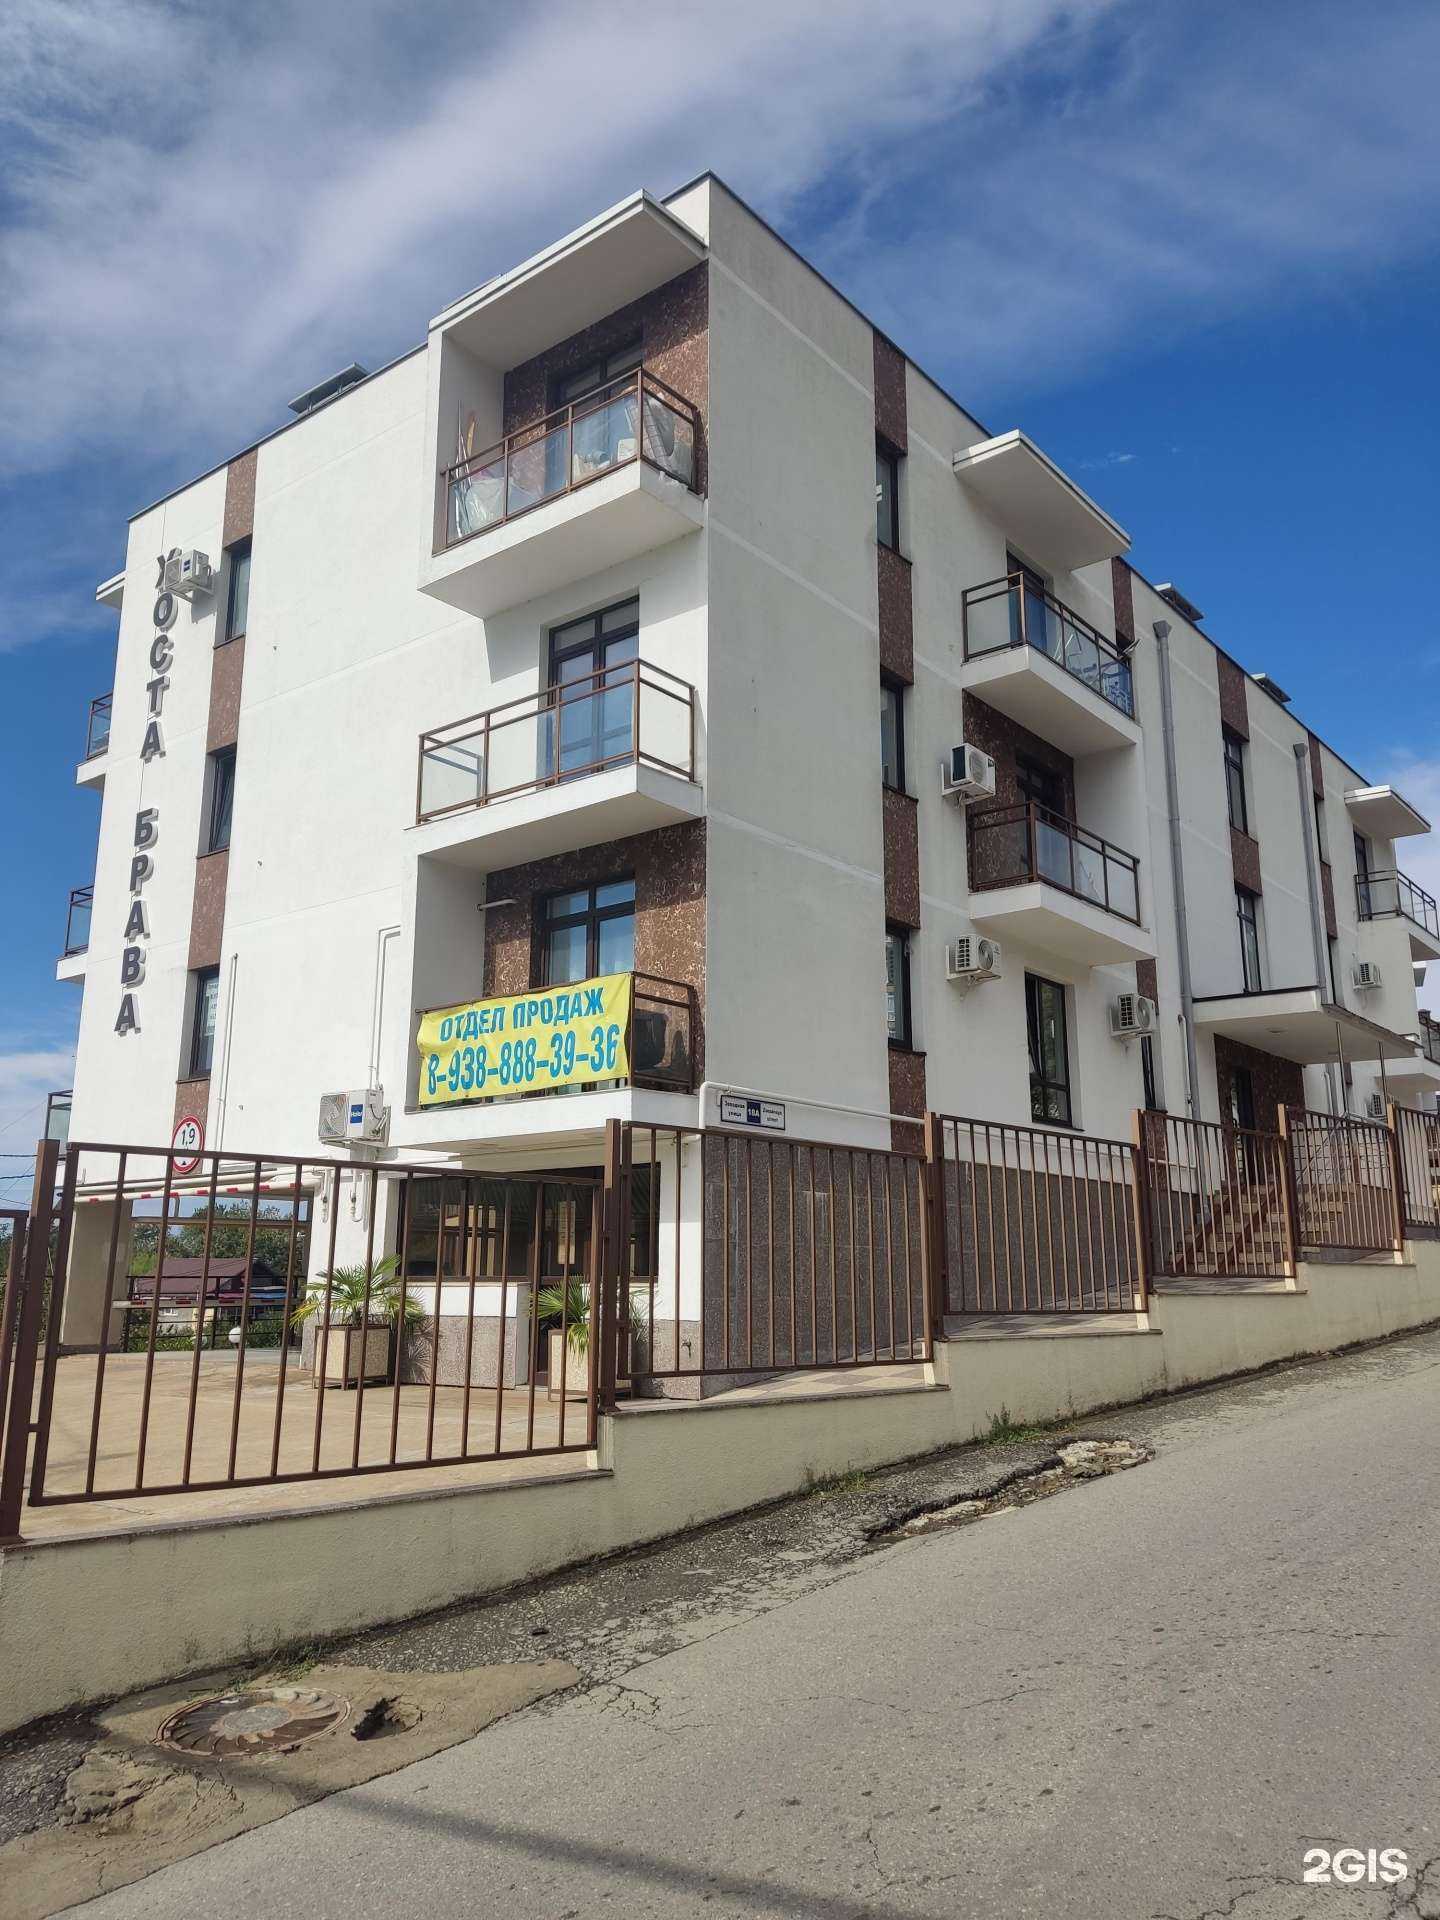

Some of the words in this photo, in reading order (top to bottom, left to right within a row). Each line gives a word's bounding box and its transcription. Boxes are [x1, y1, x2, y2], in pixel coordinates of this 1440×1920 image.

[114, 807, 159, 1037] БРАВА
[440, 1006, 506, 1042] ОТДЕЛ
[512, 987, 605, 1028] ПРОДАЖ
[427, 1023, 620, 1096] 8-938-888-39-36
